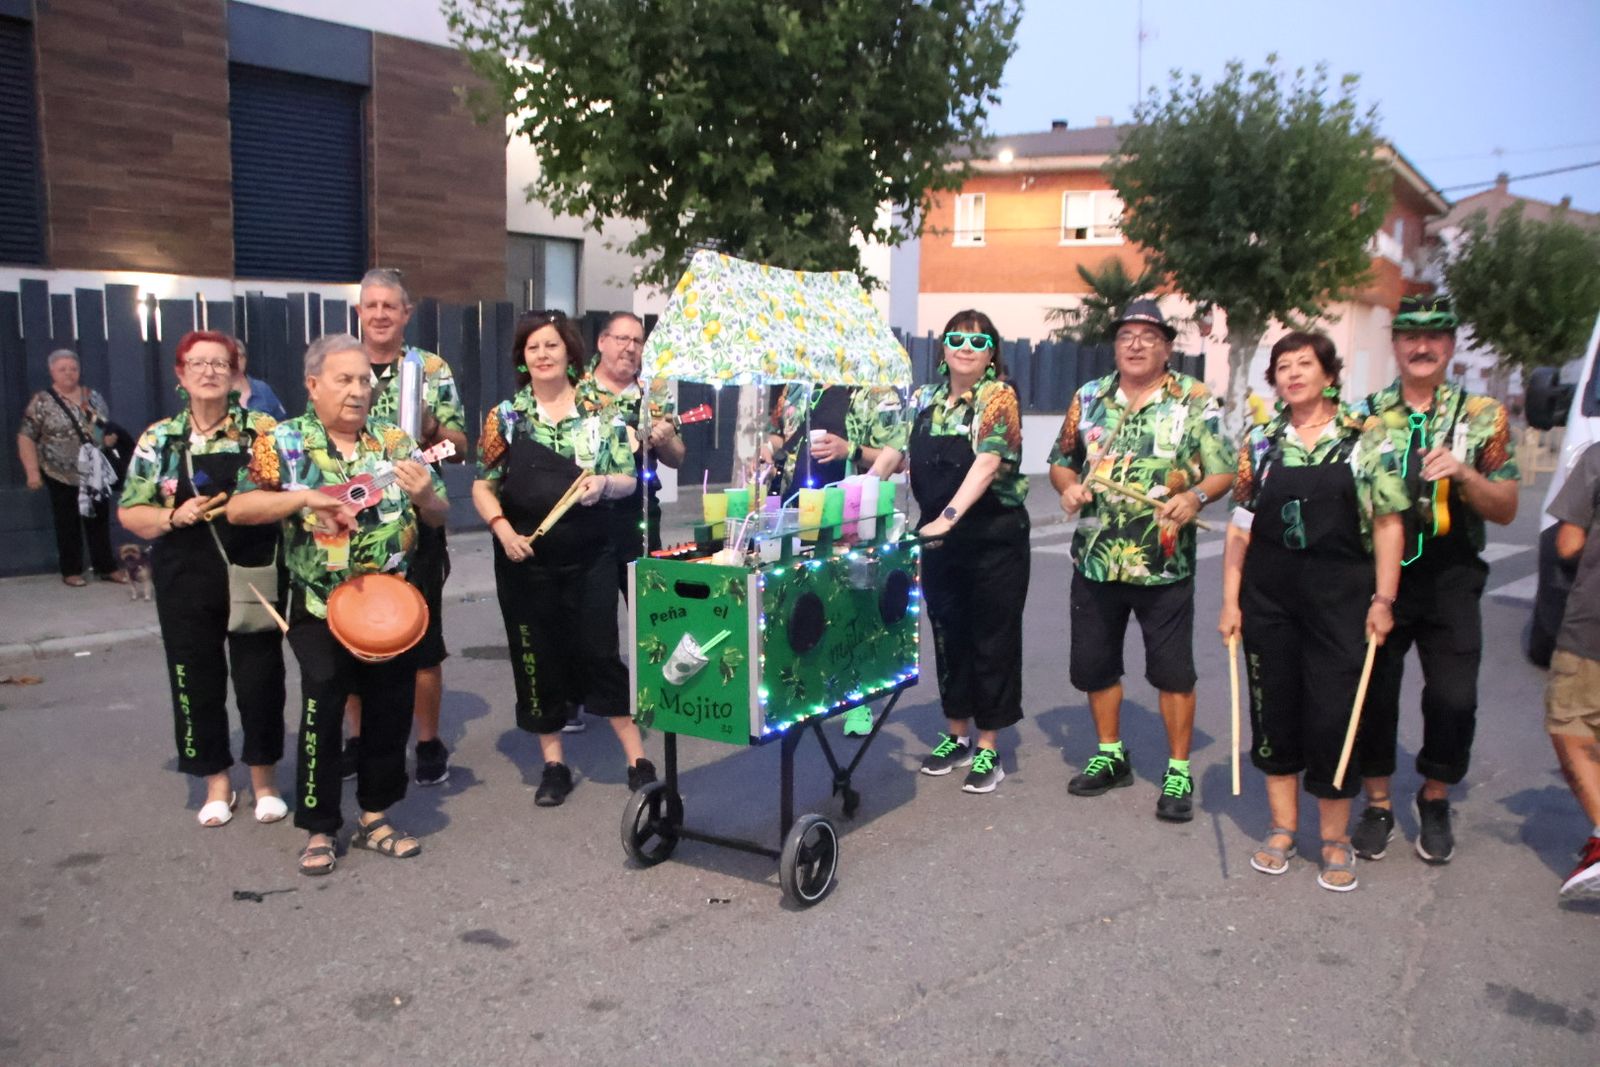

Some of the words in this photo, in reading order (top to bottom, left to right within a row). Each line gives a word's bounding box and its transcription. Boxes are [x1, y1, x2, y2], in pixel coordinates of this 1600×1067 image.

[649, 606, 688, 627] Peña
[713, 605, 728, 619] el
[175, 664, 186, 688] EL
[307, 698, 317, 726] EL
[658, 688, 732, 725] Mojito
[305, 731, 317, 808] MOJITO
